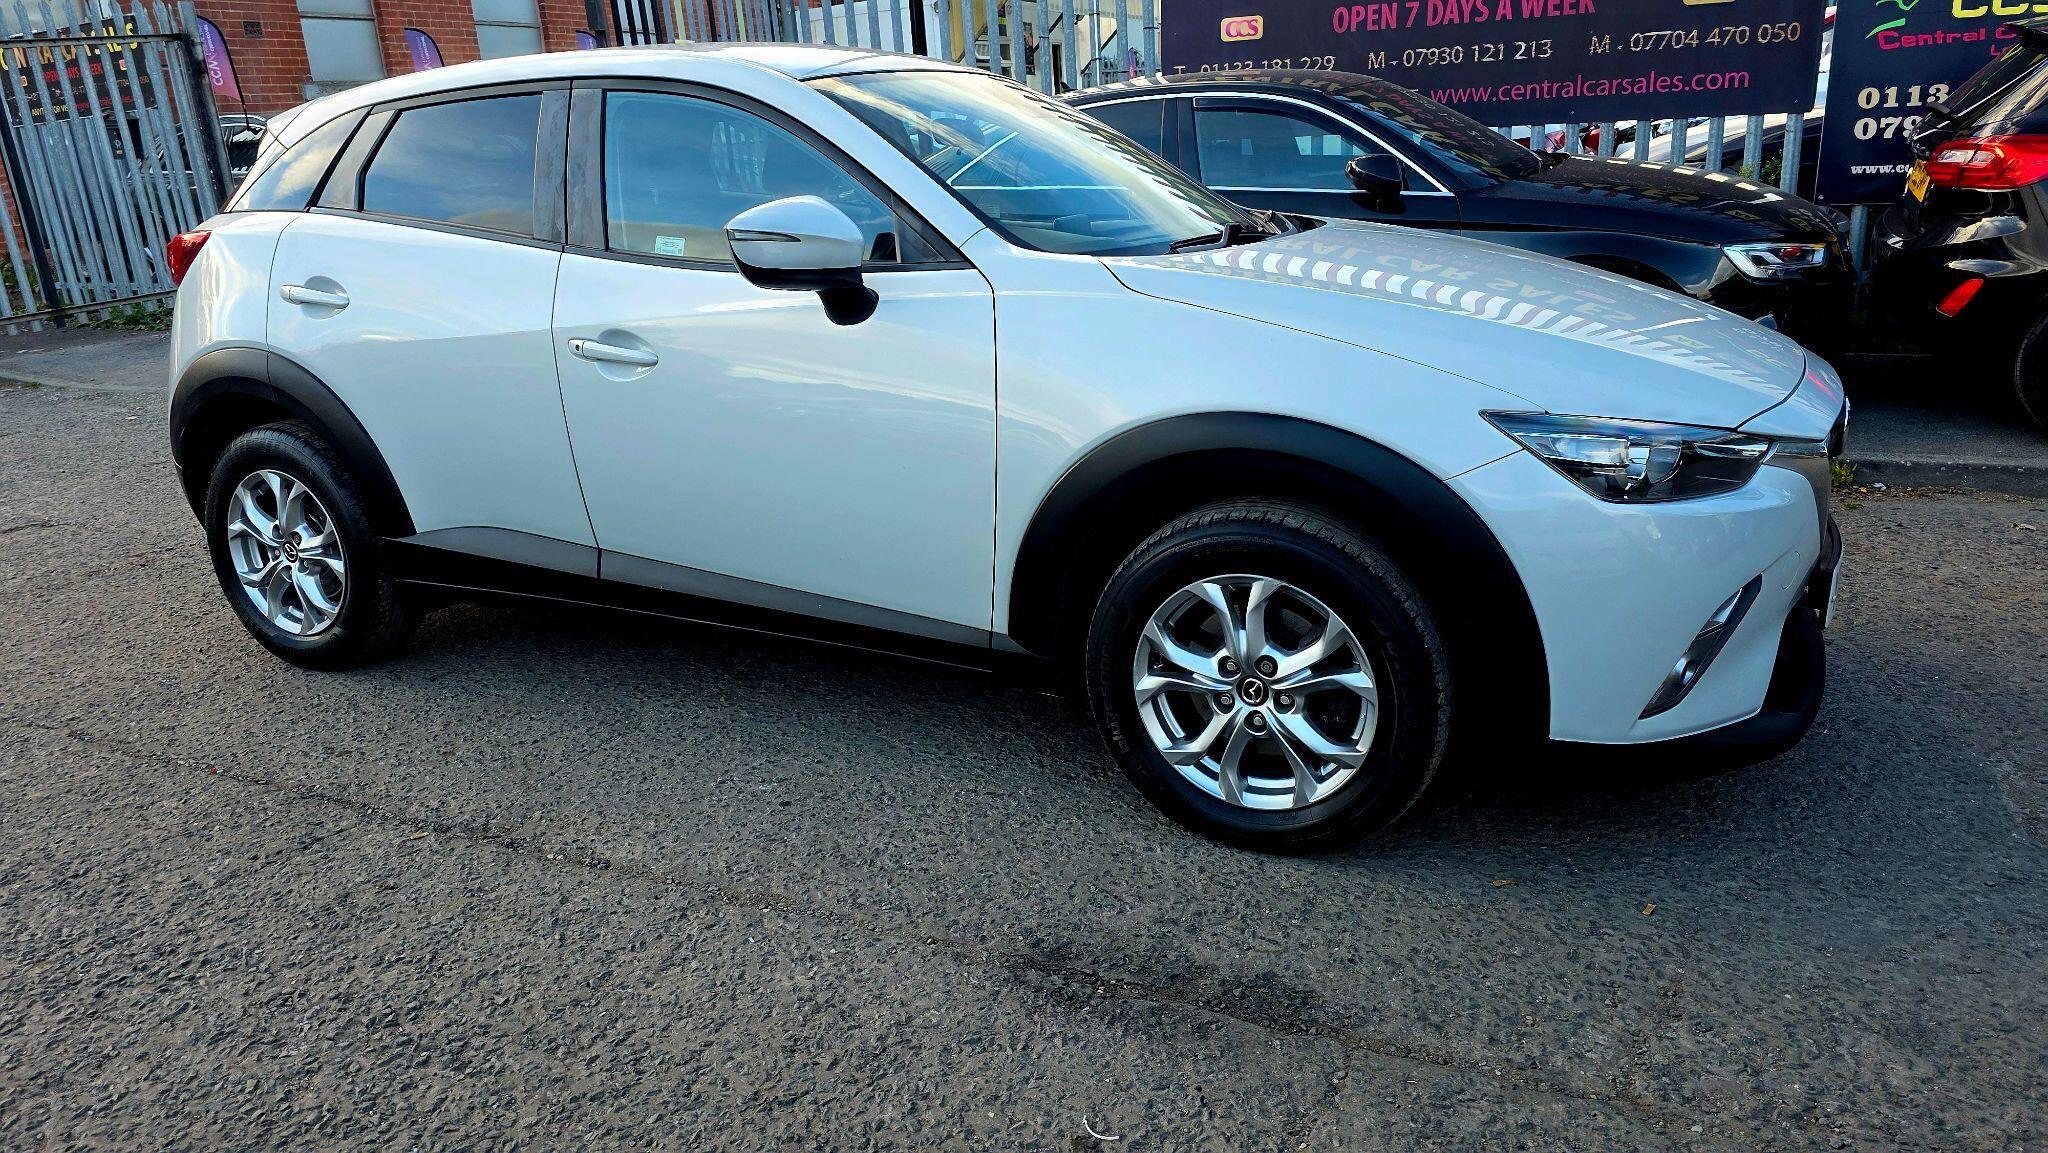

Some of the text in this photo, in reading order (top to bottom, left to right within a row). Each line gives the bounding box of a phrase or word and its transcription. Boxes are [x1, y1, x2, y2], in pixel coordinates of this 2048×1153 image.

[1333, 0, 1596, 33] OPEN 7 DAYS A WEEK
[1590, 34, 1611, 54] M
[1630, 29, 1699, 52] 07704
[1705, 25, 1750, 47] 470
[1757, 22, 1801, 44] 050
[1878, 27, 1986, 50] Central
[1368, 52, 1385, 69] M
[1403, 45, 1464, 67] 07930
[1471, 43, 1505, 62] 121
[1513, 39, 1552, 59] 213
[1430, 71, 1749, 104] www.centralcarsales.com
[1858, 83, 1950, 109] 0113
